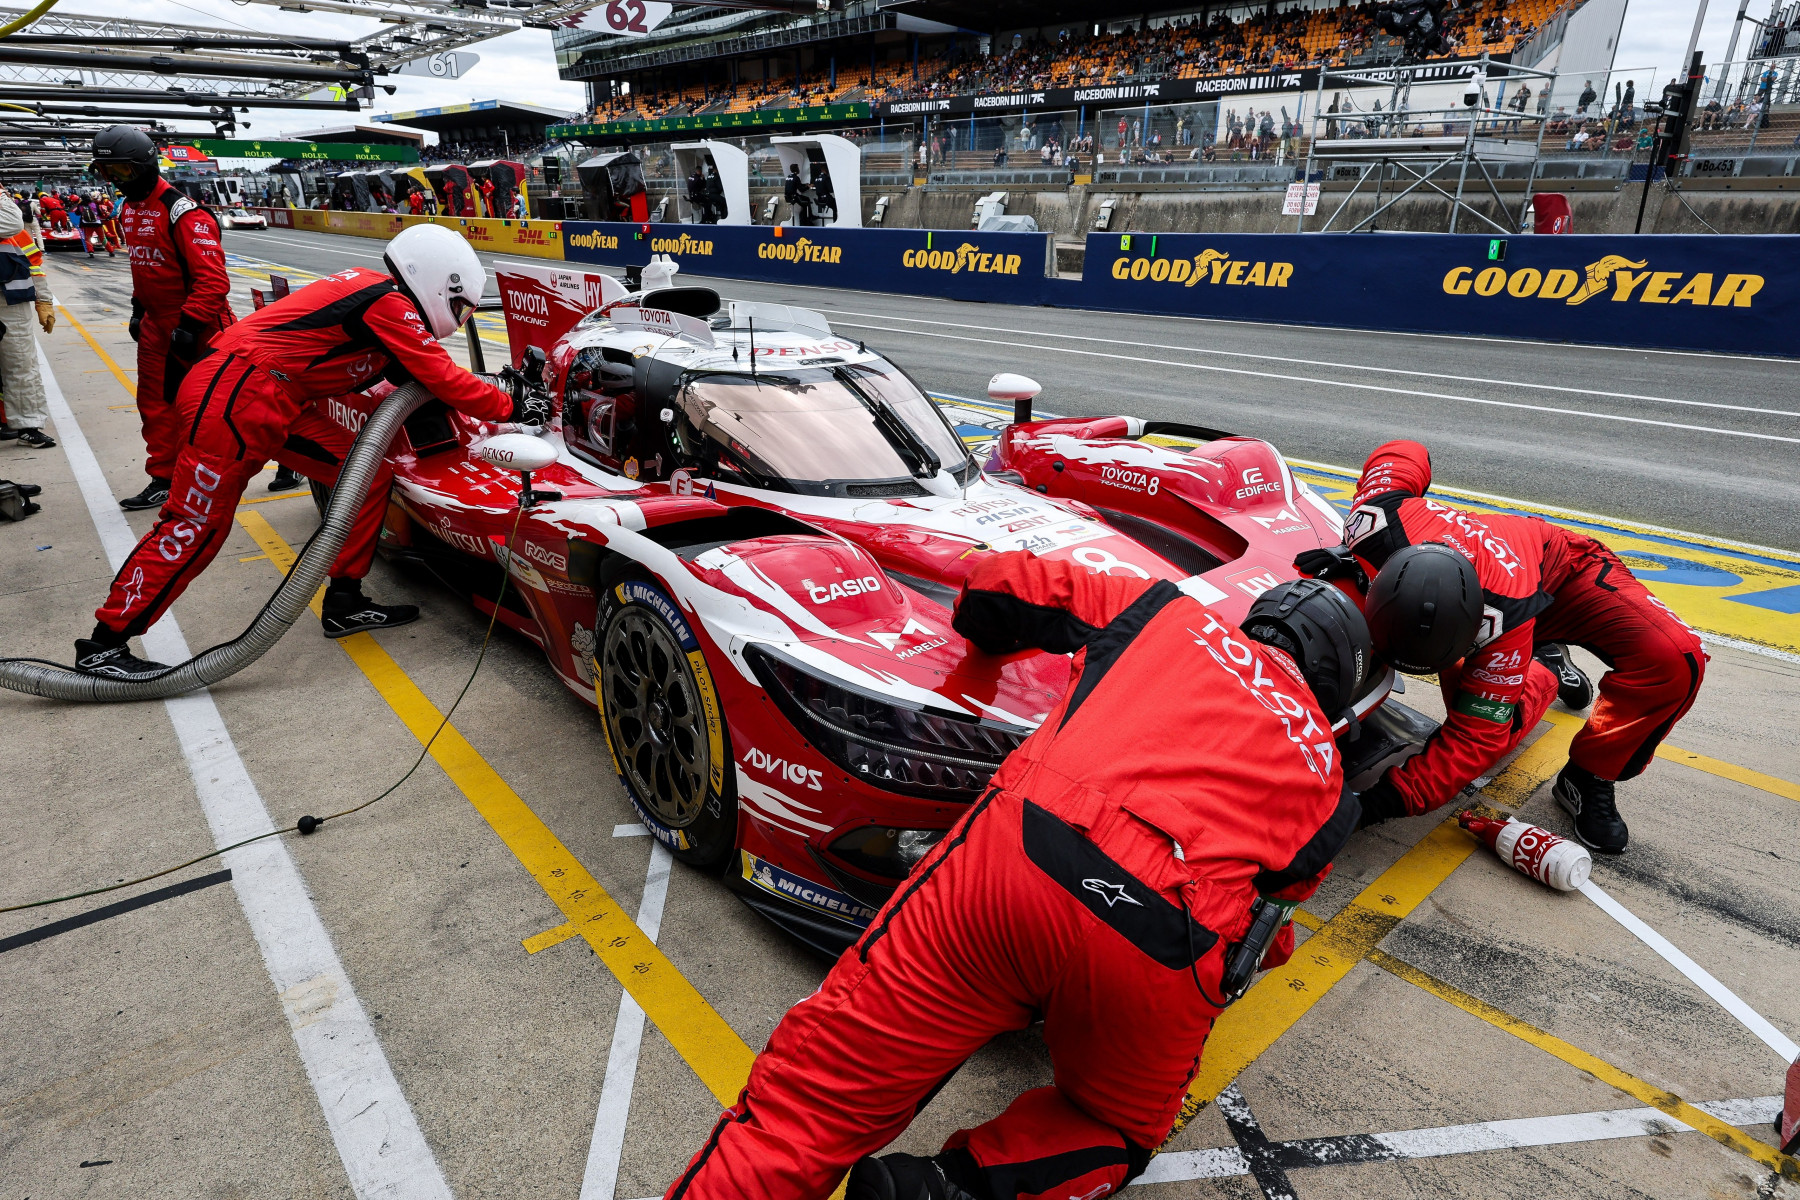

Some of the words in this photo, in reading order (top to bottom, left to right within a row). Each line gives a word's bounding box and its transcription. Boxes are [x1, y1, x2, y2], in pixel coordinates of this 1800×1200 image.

[606, 0, 648, 33] 62
[428, 52, 458, 78] 61
[1074, 88, 1117, 101] RACEBORN
[1143, 84, 1160, 97] 75
[1195, 78, 1248, 93] RACEBORN
[1281, 74, 1301, 87] 75
[890, 103, 921, 114] RACEBORN
[938, 99, 950, 110] 75
[974, 96, 1010, 108] RACEBORN
[1031, 93, 1045, 104] 75
[244, 150, 273, 158] ROLEX
[1340, 167, 1351, 177] Box
[1351, 166, 1360, 176] 52
[1720, 159, 1734, 172] 53
[514, 229, 549, 246] DHL
[570, 231, 618, 249] GOODYEAR
[651, 235, 713, 255] GOODYEAR
[758, 240, 842, 263] GOODYEAR
[902, 246, 1022, 274] GOODYEAR
[1111, 252, 1294, 288] GOODYEAR
[559, 282, 580, 290] AIRLINES
[1442, 258, 1765, 308] GOODYEAR
[507, 289, 549, 316] TOYOTA
[585, 281, 601, 308] HY
[509, 313, 550, 327] RACING
[638, 308, 672, 325] TOYOTA
[748, 341, 853, 357] DENSO
[327, 397, 369, 434] DENSO
[482, 446, 514, 462] DENSO
[1099, 478, 1146, 493] RACING
[1100, 465, 1148, 487] TOYOTA
[1147, 476, 1160, 496] 8
[1235, 481, 1282, 500] EDIFICE
[158, 462, 222, 562] DENSO
[949, 498, 1019, 518] FUJITSU
[975, 506, 1039, 526] AISIN
[998, 515, 1053, 533] ZENT
[1271, 523, 1312, 536] MARELLI
[1426, 500, 1519, 578] TOYOTA
[1442, 534, 1475, 559] DENSO
[524, 540, 567, 572] RAYS
[1071, 546, 1151, 580] 8
[809, 576, 881, 605] CASIO
[633, 585, 690, 642] MICHELIN
[895, 636, 949, 661] MARELLI
[1472, 668, 1523, 686] RAYS
[693, 660, 708, 693] PILOT
[704, 695, 717, 737] SPORT
[1201, 613, 1334, 776] TOYOTA
[1186, 627, 1327, 785] RACING
[742, 747, 823, 792] ADVICS
[551, 868, 565, 878] 20
[570, 889, 584, 901] 10
[777, 878, 878, 920] MICHELIN
[1381, 894, 1397, 905] 20
[611, 936, 627, 948] 10
[633, 962, 650, 974] 20
[1288, 978, 1305, 992] 20
